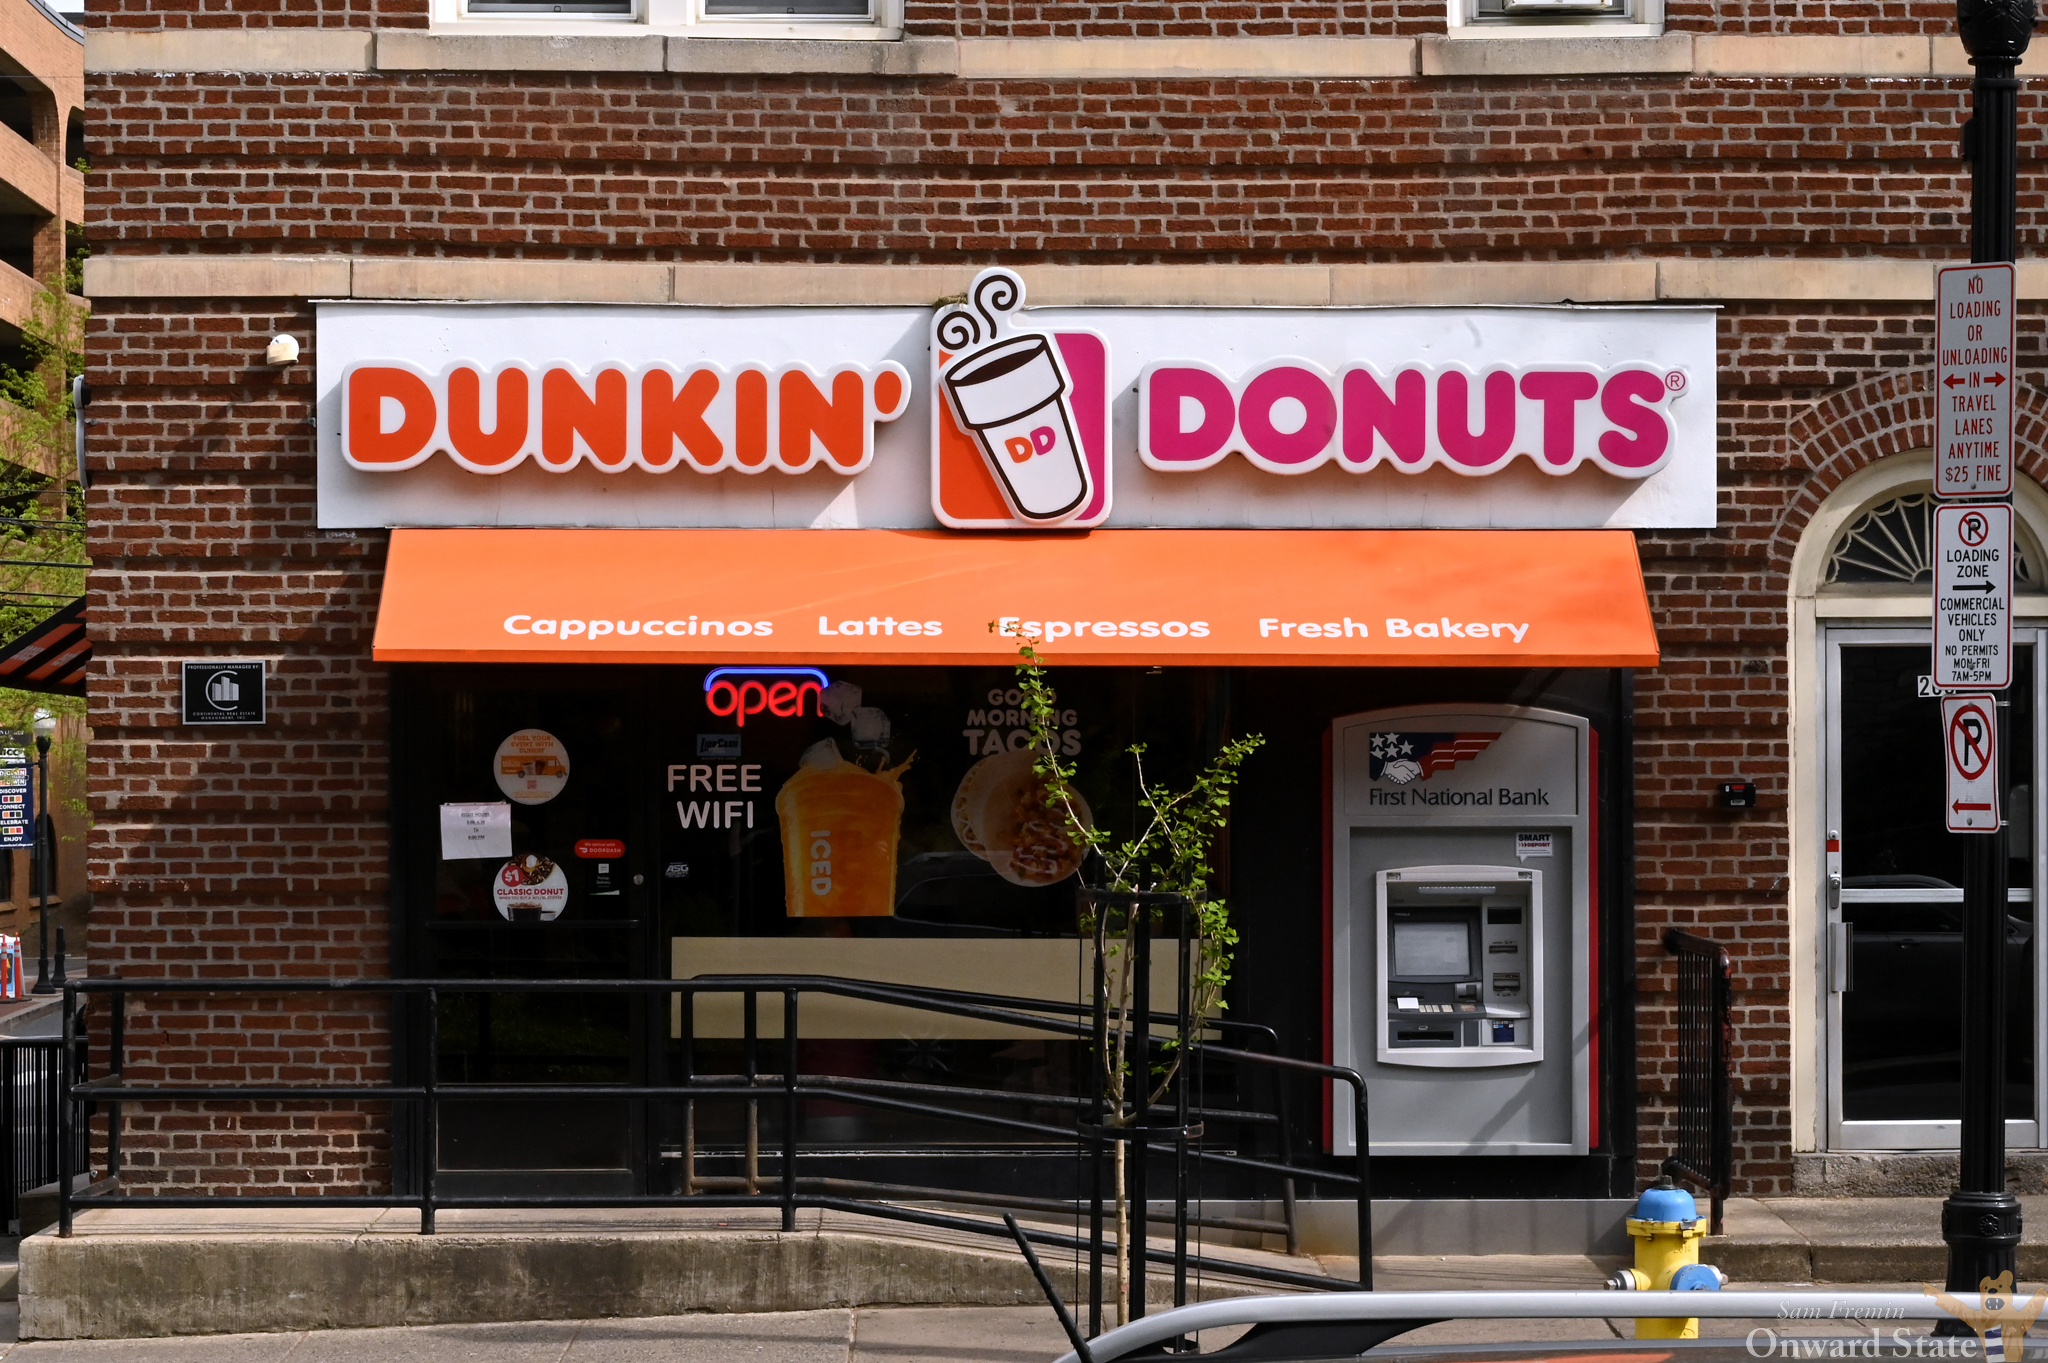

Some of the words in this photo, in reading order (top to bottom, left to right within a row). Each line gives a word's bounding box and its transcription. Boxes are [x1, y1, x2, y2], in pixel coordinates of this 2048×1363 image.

[1968, 277, 1984, 294] NO
[1950, 300, 2001, 319] LOADING
[1968, 325, 1983, 341] OR
[1942, 347, 2007, 366] UNLOADING
[1969, 372, 1980, 388] IN
[1952, 394, 1997, 412] TRAVEL
[348, 367, 902, 468] DUNKIN'
[1149, 367, 1667, 468] DONUTS
[1955, 418, 1993, 435] LANES
[1005, 426, 1056, 463] DD
[1948, 441, 1999, 459] ANYTIME
[1945, 466, 1968, 483] $25
[1976, 464, 2001, 482] FINE
[1946, 549, 1999, 562] LOADING
[1957, 565, 1989, 578] ZONE
[1940, 597, 2005, 611] COMMERCIAL
[1947, 613, 1997, 626] VEHICLES
[503, 615, 774, 641] Cappuccinos
[819, 615, 942, 637] Lattes
[997, 616, 1211, 643] Espressos
[1259, 616, 1369, 638] Fresh
[1386, 616, 1530, 644] Bakery
[1958, 629, 1985, 642] ONLY
[1945, 645, 1957, 656] NO
[1961, 645, 1999, 656] PERMITS
[1953, 658, 1990, 669] MON-FRI
[1951, 671, 1991, 682] 7AM-5PM
[706, 680, 824, 727] open
[962, 729, 1082, 756] TACOS
[667, 764, 762, 792] FREE
[1370, 788, 1406, 806] First
[1412, 788, 1492, 806] National
[1499, 788, 1549, 806] Bank
[676, 800, 754, 829] WIFI
[666, 864, 690, 872] ASG
[810, 830, 832, 895] ICED
[504, 869, 520, 883] $1
